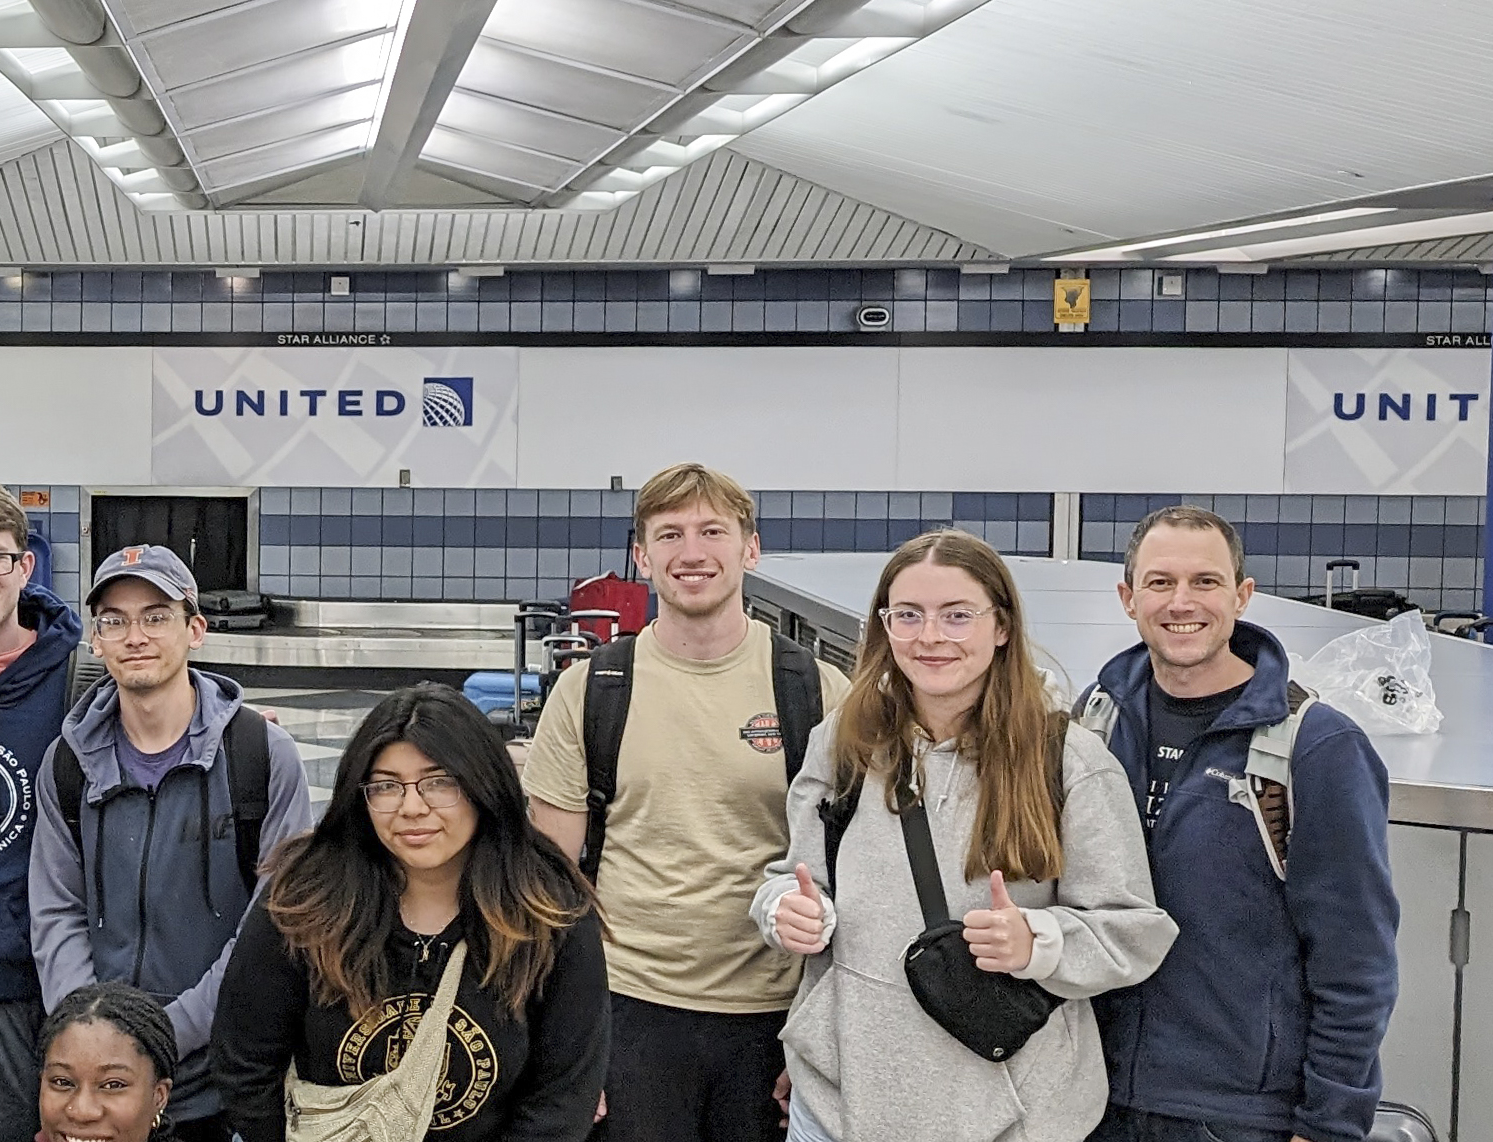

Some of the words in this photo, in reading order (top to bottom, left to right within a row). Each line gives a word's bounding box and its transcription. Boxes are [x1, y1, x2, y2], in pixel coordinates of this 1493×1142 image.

[278, 335, 310, 345] STAR
[314, 335, 376, 345] ALLIANCE
[1426, 335, 1461, 345] STAR
[195, 390, 406, 416] UNITED
[1334, 393, 1479, 421] UNIT
[16, 768, 33, 812] PAULO
[454, 1017, 485, 1053] SÃO
[462, 1057, 492, 1111] PAULO
